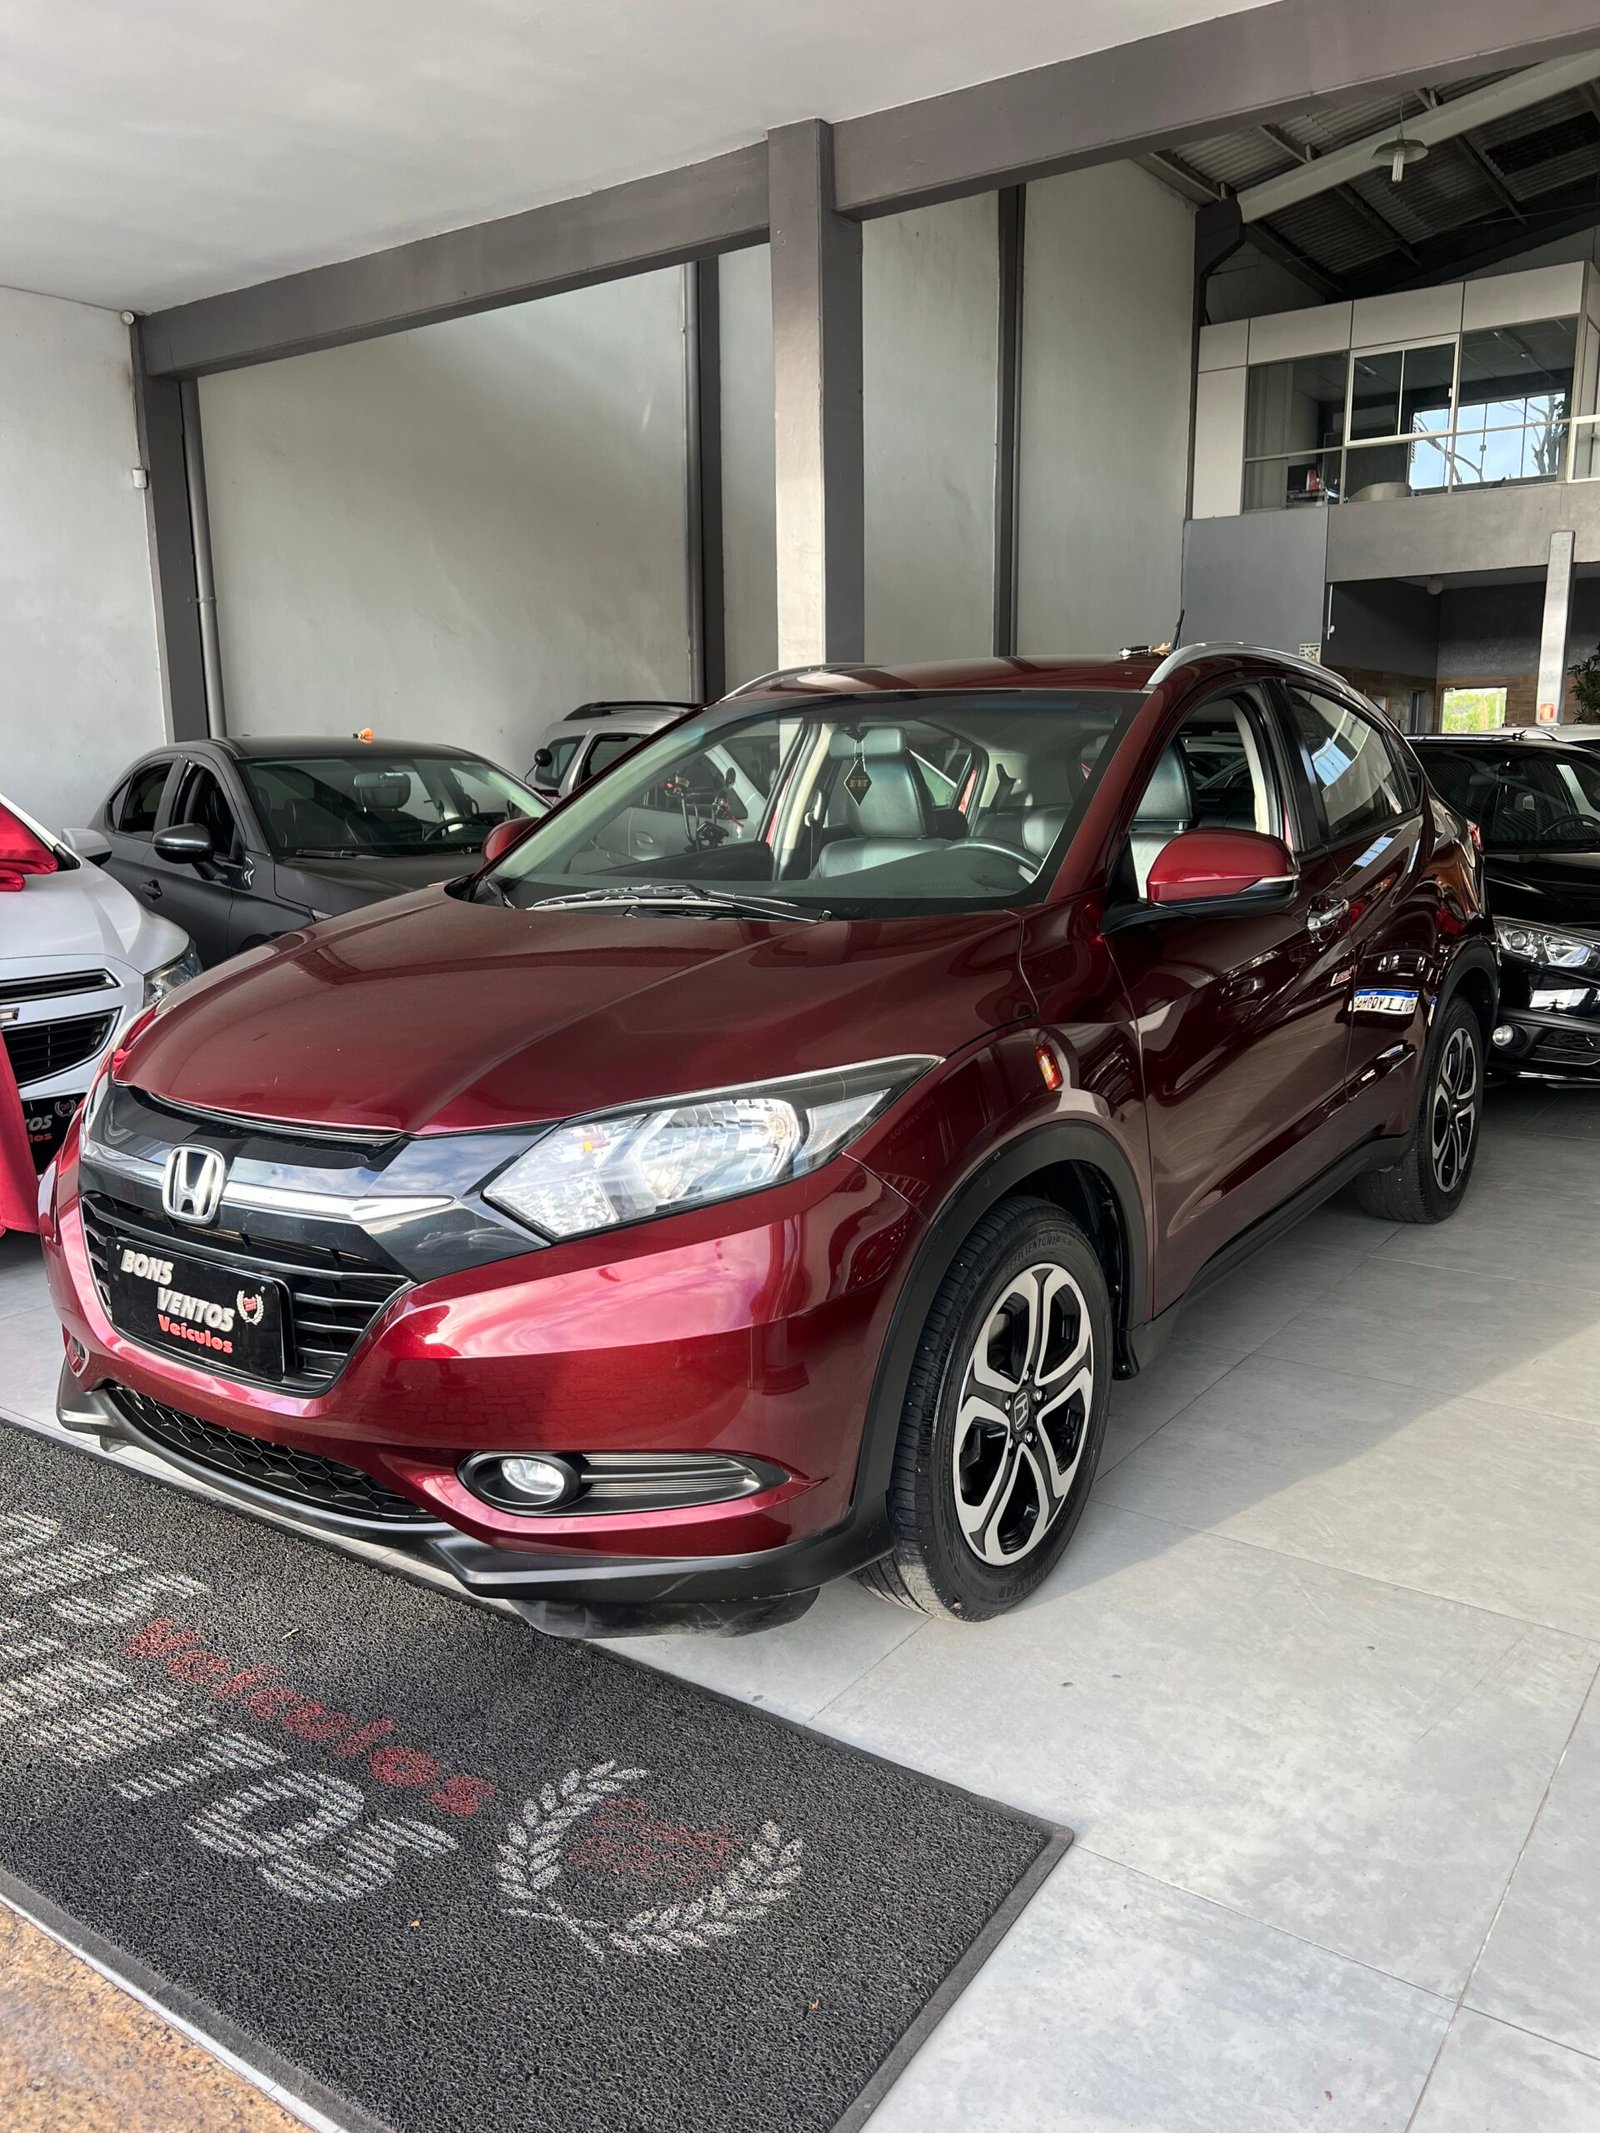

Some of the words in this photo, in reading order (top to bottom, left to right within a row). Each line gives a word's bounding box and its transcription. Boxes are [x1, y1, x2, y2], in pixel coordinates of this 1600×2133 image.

[120, 1249, 174, 1286] BONS
[156, 1287, 236, 1333] VENTOS
[157, 1314, 233, 1354] Veículos
